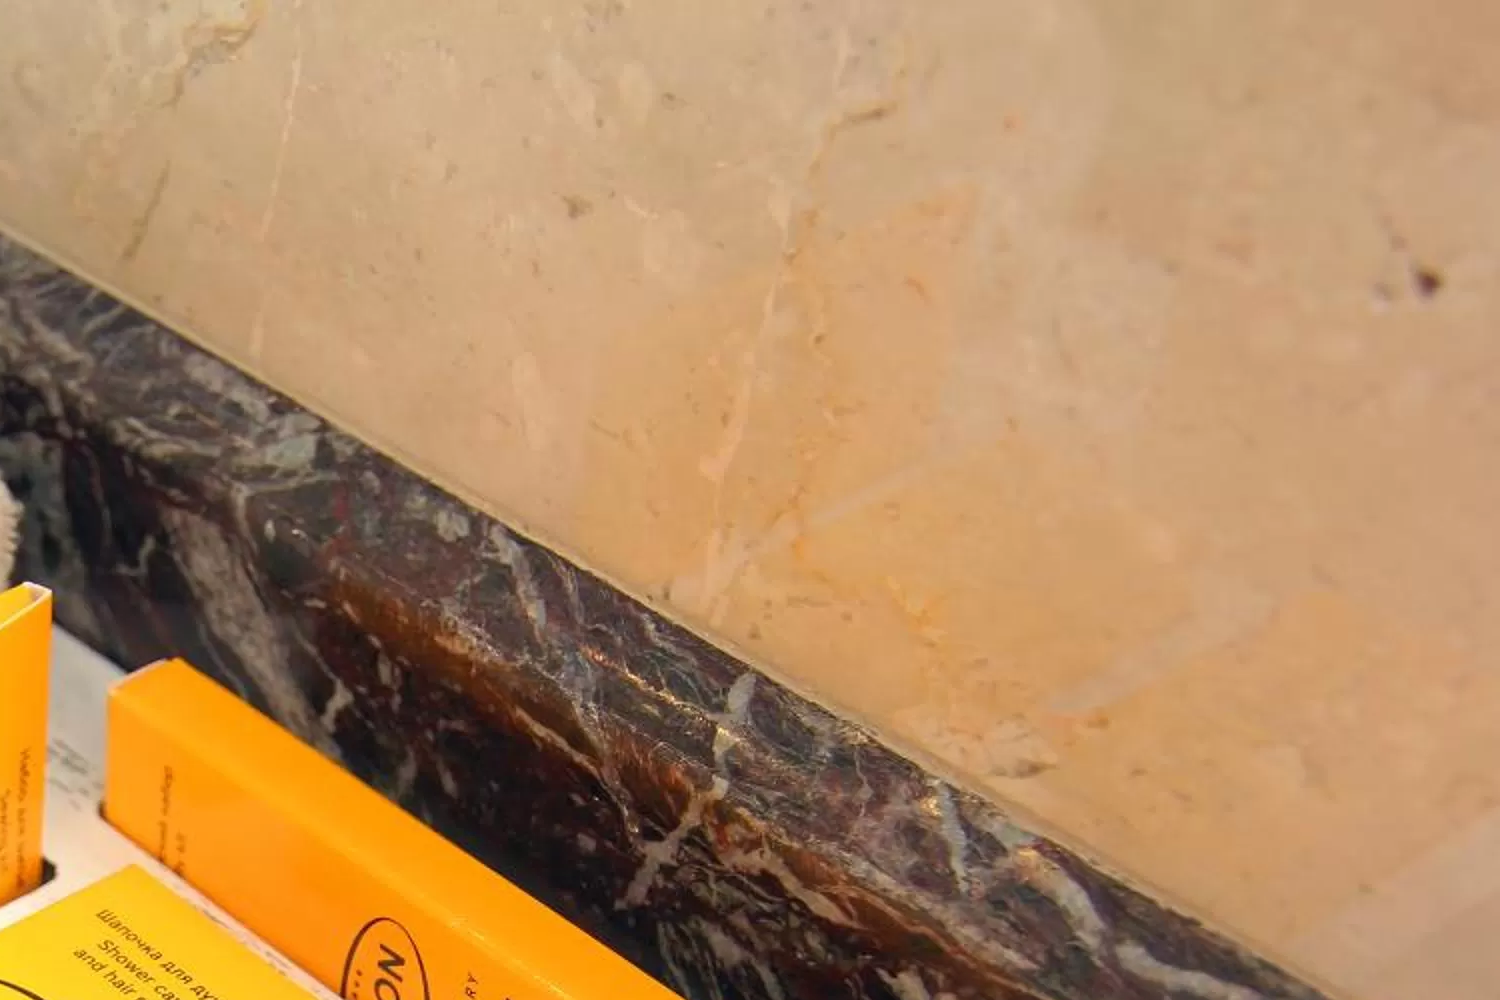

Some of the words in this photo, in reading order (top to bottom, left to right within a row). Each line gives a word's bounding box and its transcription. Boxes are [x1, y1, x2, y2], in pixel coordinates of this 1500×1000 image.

[96, 909, 163, 962] Шапочка
[159, 961, 193, 985] для
[97, 939, 155, 985] Shower
[73, 949, 107, 974] and
[103, 968, 137, 995] hair
